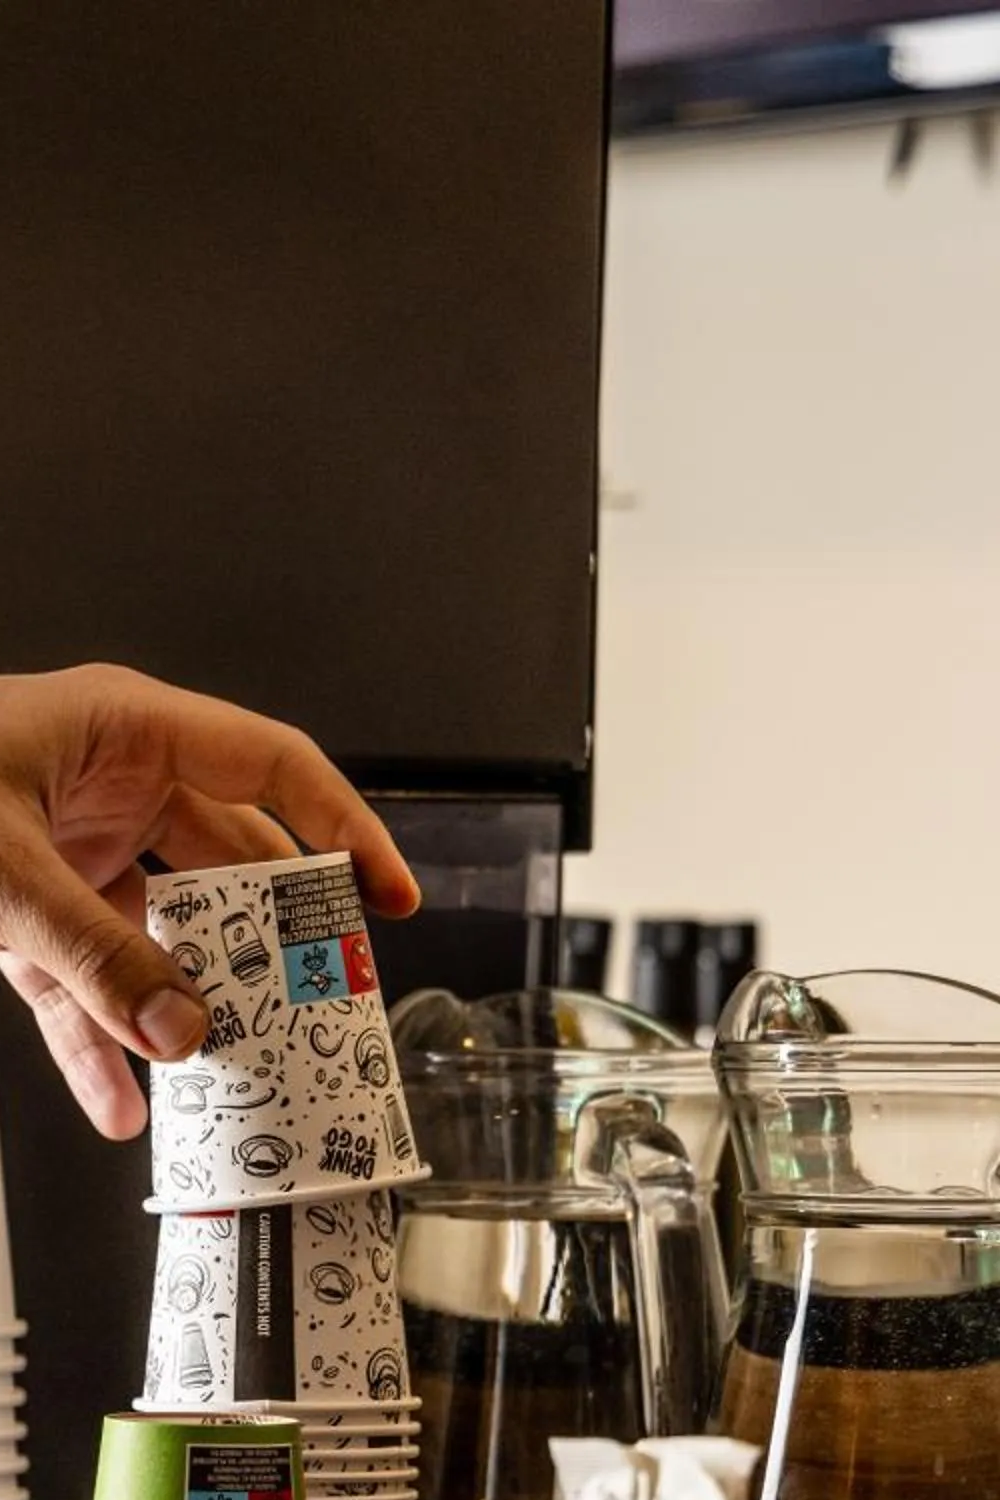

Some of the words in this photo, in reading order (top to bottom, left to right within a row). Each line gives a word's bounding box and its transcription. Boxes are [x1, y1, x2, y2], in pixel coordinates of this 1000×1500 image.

[327, 1127, 353, 1149] GO
[355, 1136, 377, 1156] TO
[318, 1147, 376, 1180] DRINK
[258, 1212, 271, 1259] CAUTION
[257, 1261, 271, 1314] CONTENTS
[257, 1315, 271, 1336] HOT
